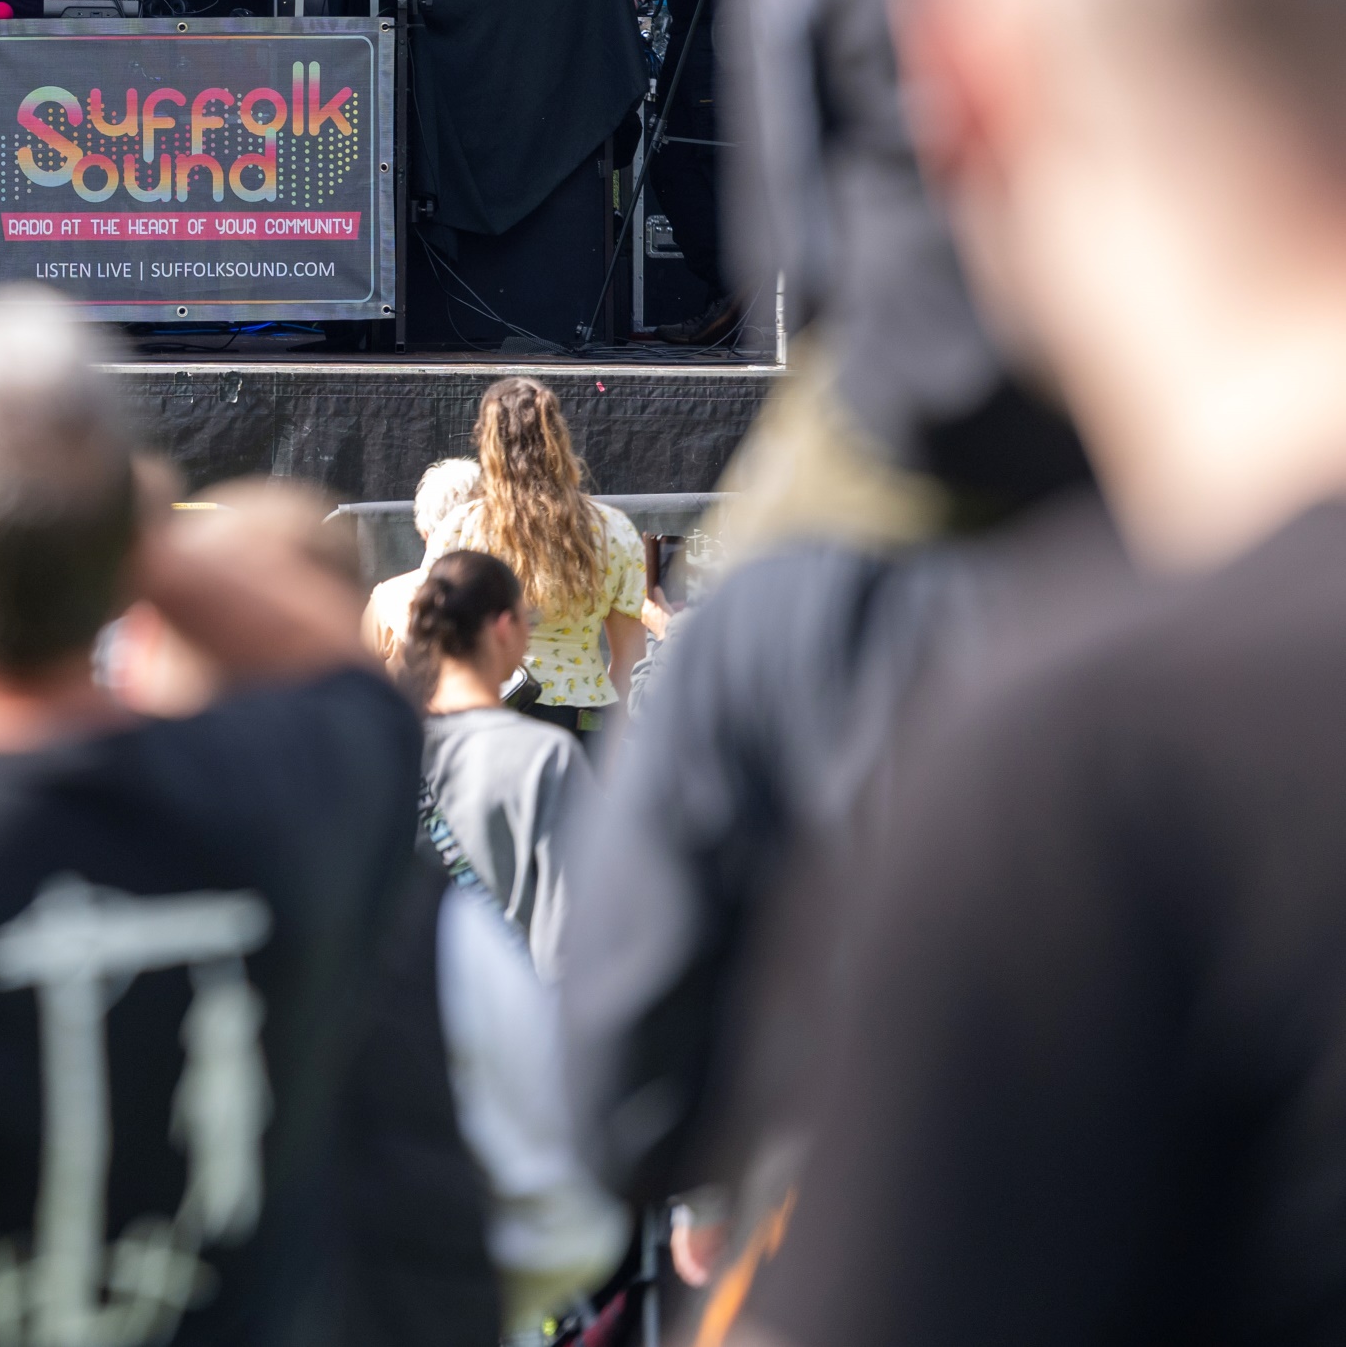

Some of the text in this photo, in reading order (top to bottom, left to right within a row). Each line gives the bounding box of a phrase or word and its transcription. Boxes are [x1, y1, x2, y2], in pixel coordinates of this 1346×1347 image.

[16, 60, 353, 188] Suffolk
[7, 218, 354, 236] RADIO AT THE HEART OF YOUR COMMUNITY
[35, 262, 93, 279] LISTEN
[97, 262, 133, 279] LIVE
[150, 261, 336, 279] SUFFOLKSOUND.COM
